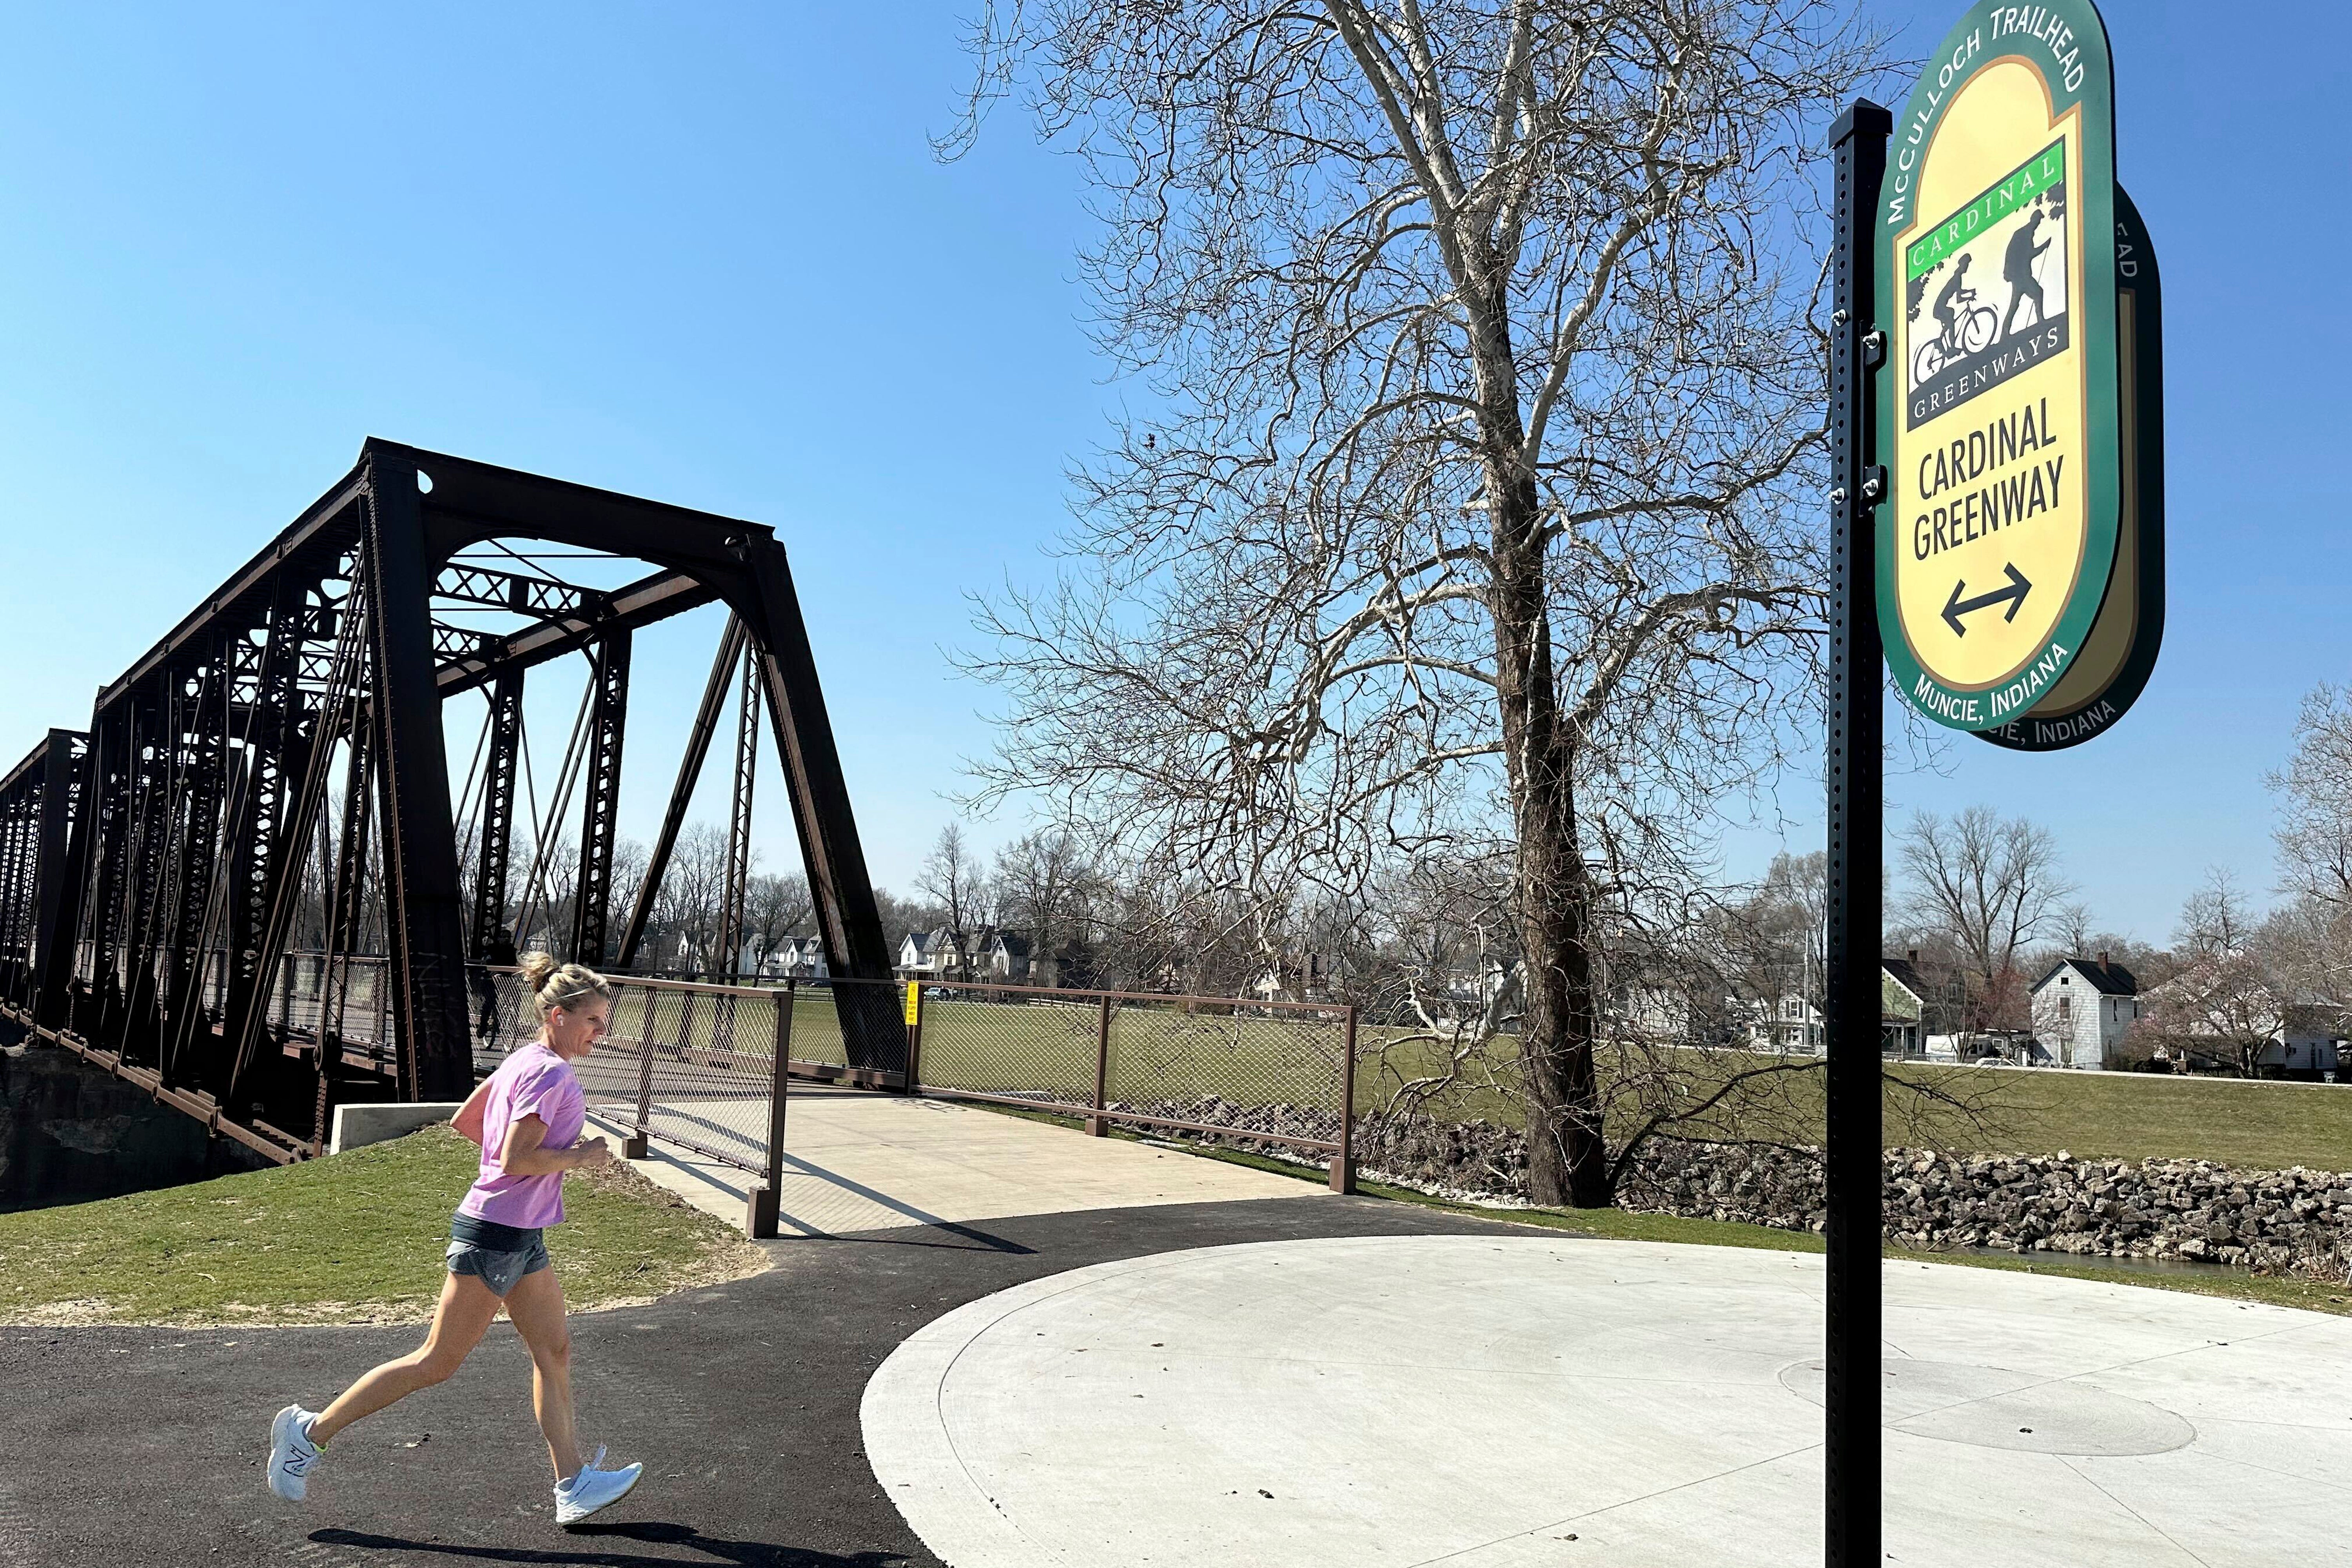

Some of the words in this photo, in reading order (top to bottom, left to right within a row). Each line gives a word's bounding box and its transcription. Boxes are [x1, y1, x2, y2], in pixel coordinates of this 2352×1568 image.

[1990, 5, 2084, 93] TRAILHEAD
[1913, 158, 2054, 266] CARDINAL
[1914, 326, 2058, 419] GREENWAYS
[1919, 397, 2056, 500] CARDINAL
[1914, 454, 2064, 561] GREENWAY
[1913, 673, 1984, 725] MUNCIE,
[1991, 642, 2068, 717] INDIANA
[2035, 700, 2116, 743] INDIANA
